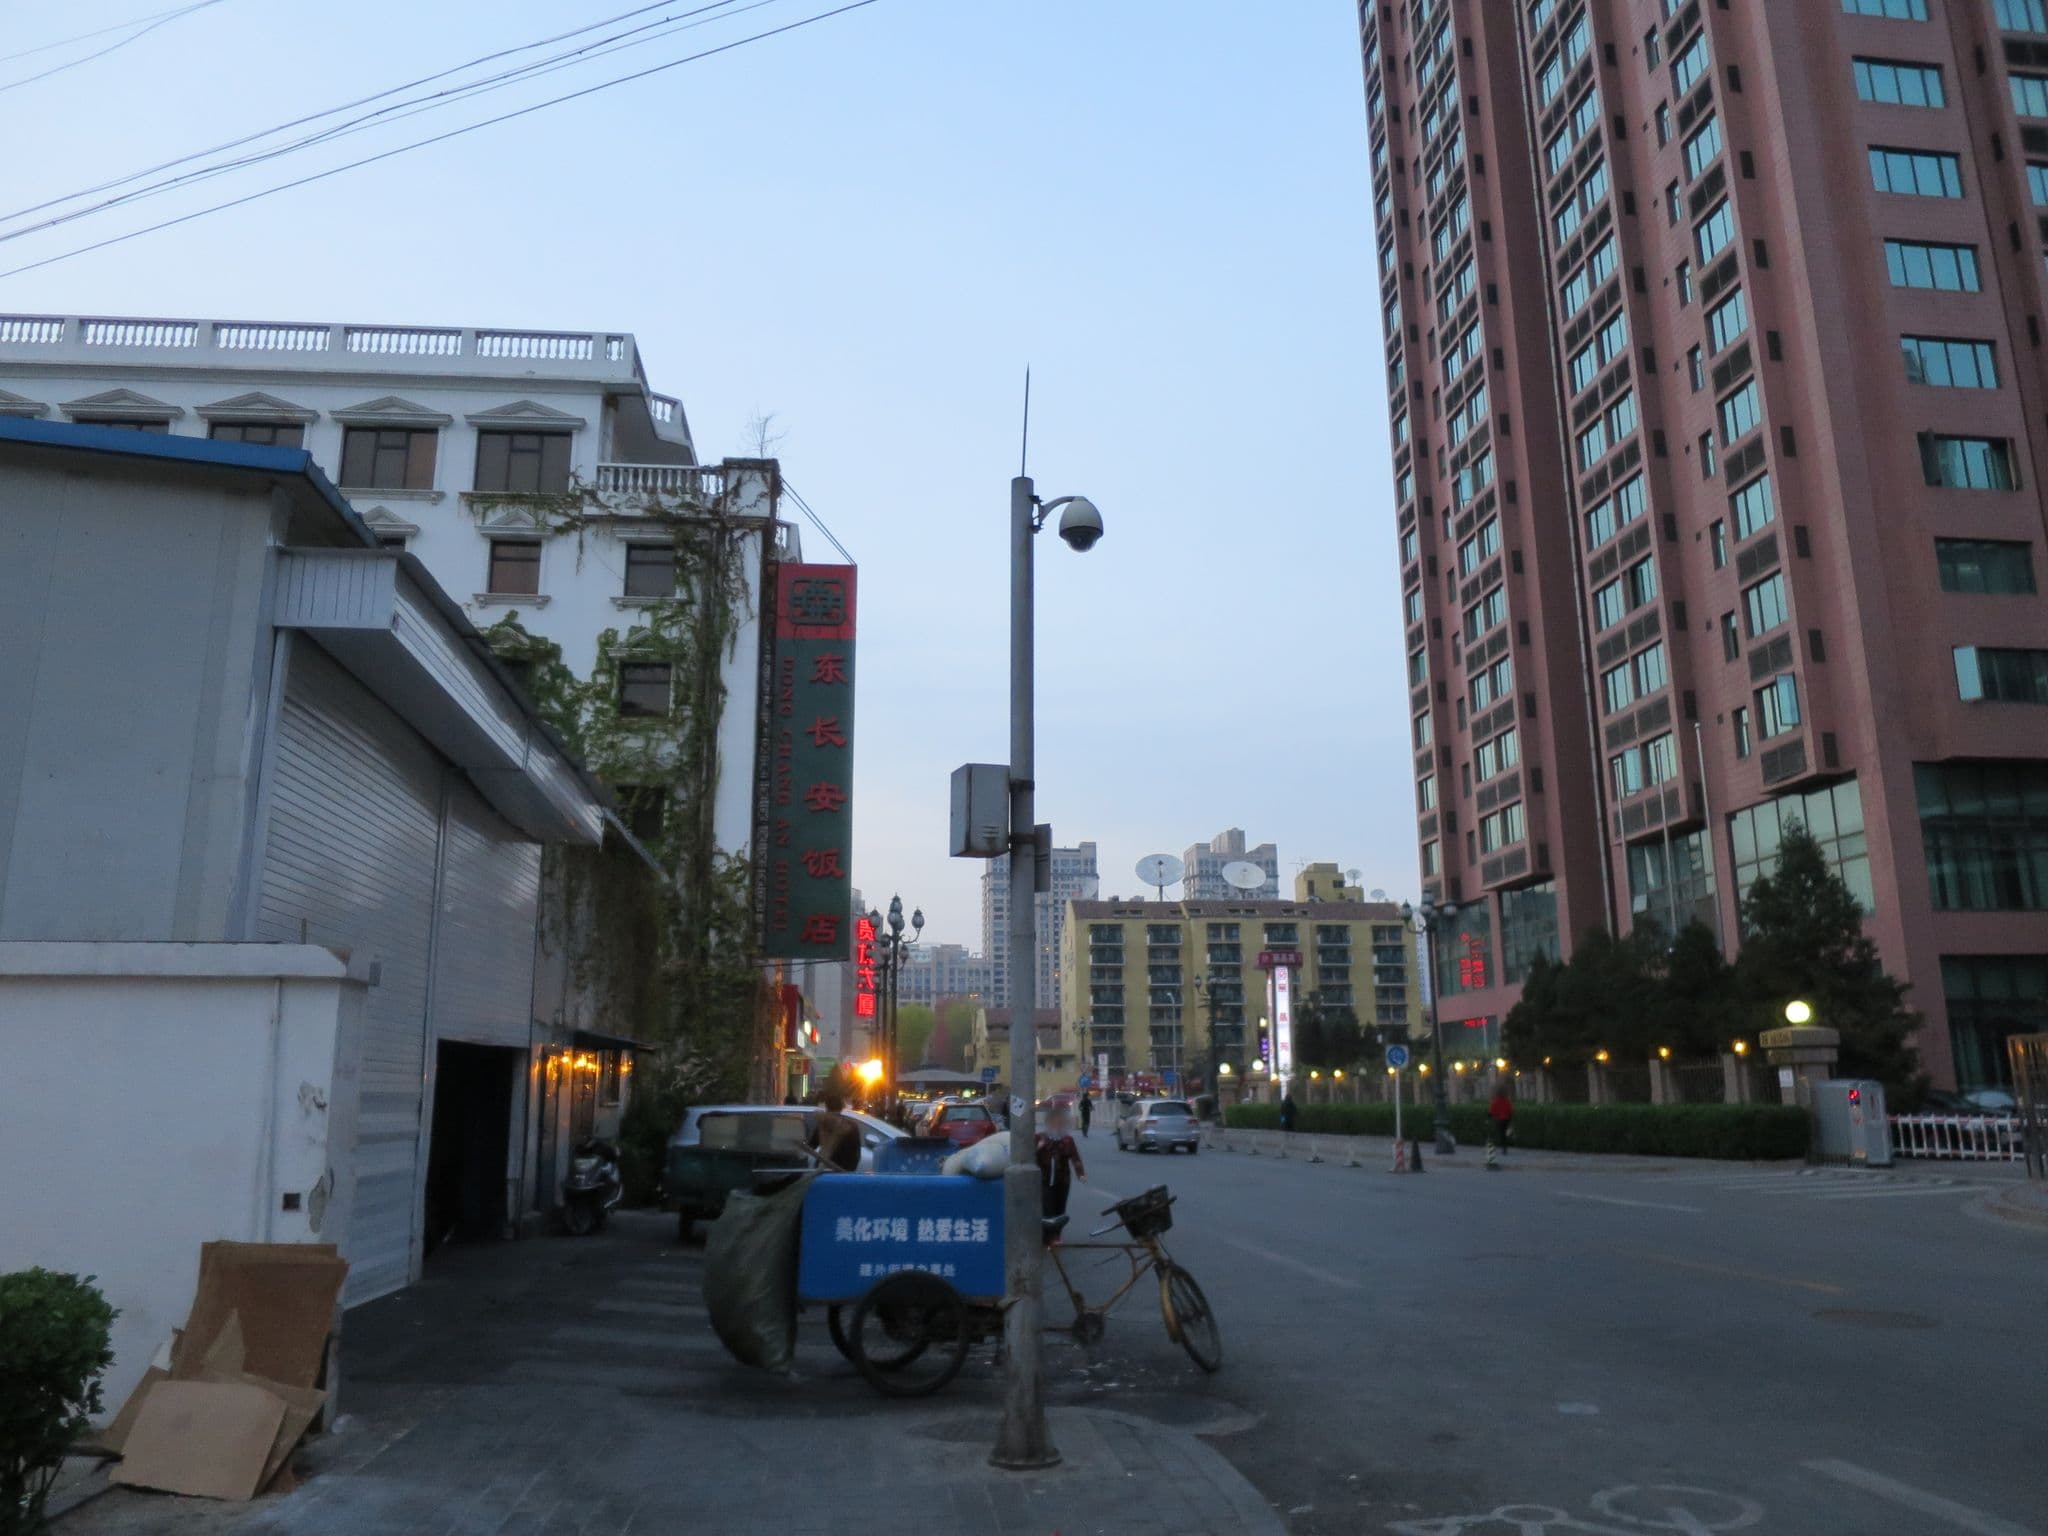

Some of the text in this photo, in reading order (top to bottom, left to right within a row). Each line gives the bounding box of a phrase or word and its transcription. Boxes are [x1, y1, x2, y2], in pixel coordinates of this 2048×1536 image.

[780, 656, 794, 717] DONG
[801, 652, 848, 944] 东长安饭店
[776, 818, 790, 844] AN
[774, 861, 788, 930] HOTEL
[835, 1216, 989, 1242] 美化环境 热爱生活
